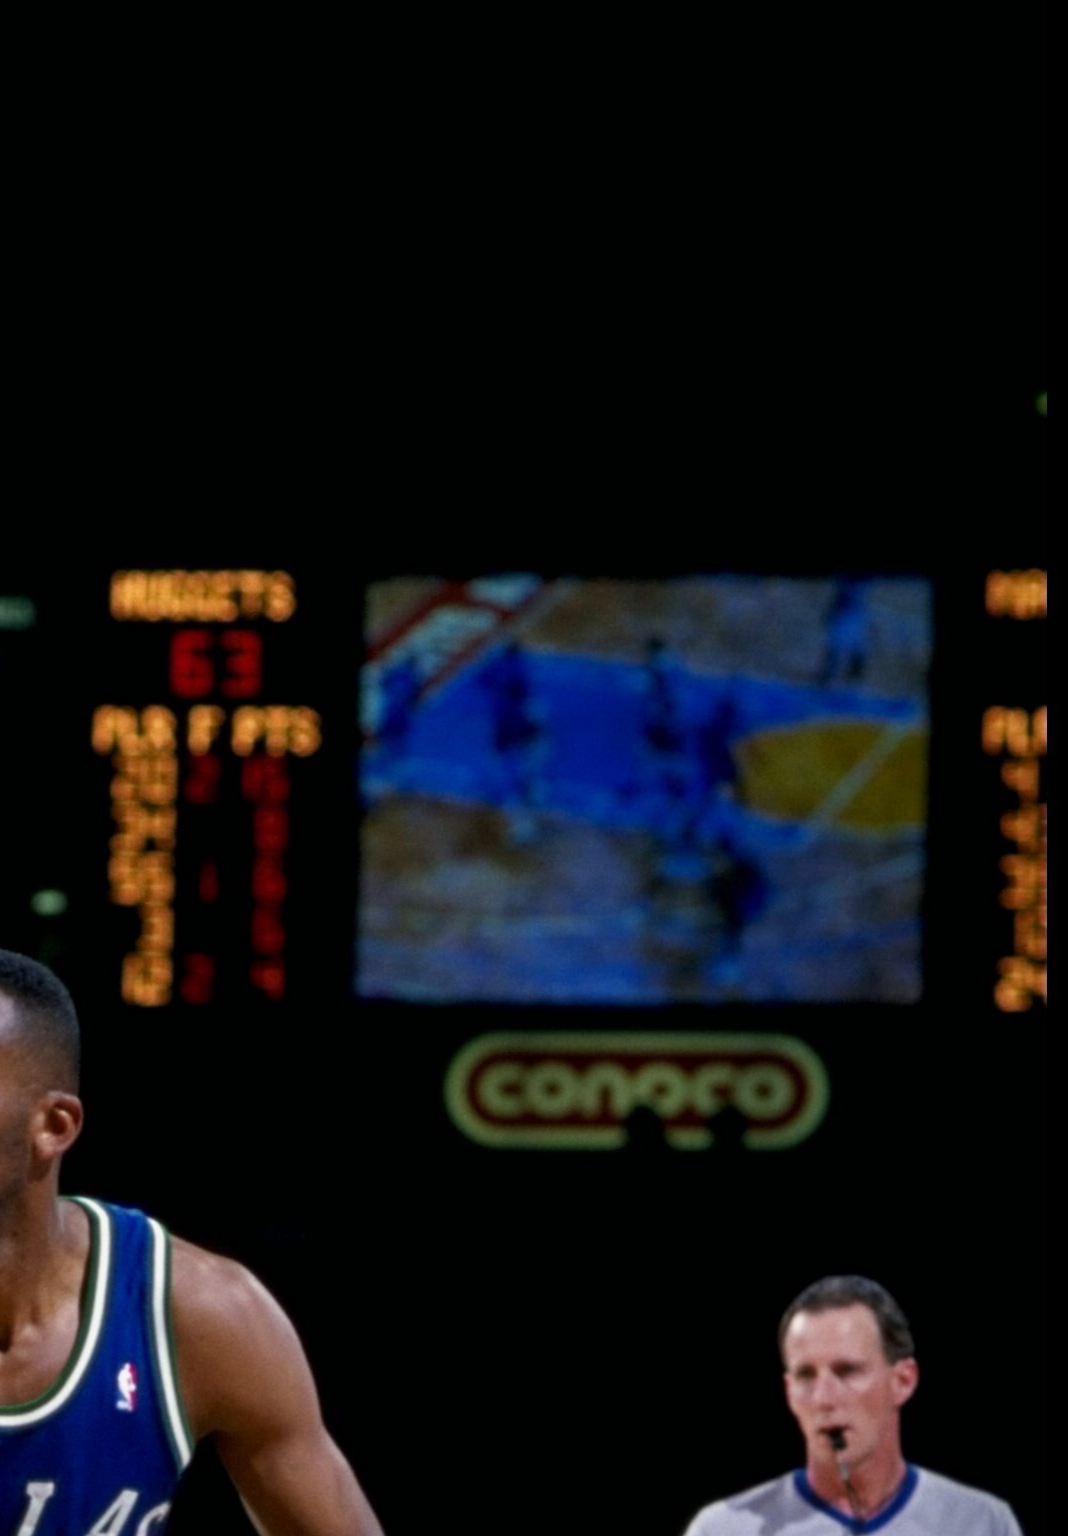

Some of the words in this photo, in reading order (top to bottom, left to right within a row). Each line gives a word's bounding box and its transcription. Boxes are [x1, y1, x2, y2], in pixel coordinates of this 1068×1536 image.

[109, 570, 296, 622] NUGGETS
[170, 629, 263, 698] 63
[187, 704, 225, 757] F
[232, 705, 322, 757] PTS
